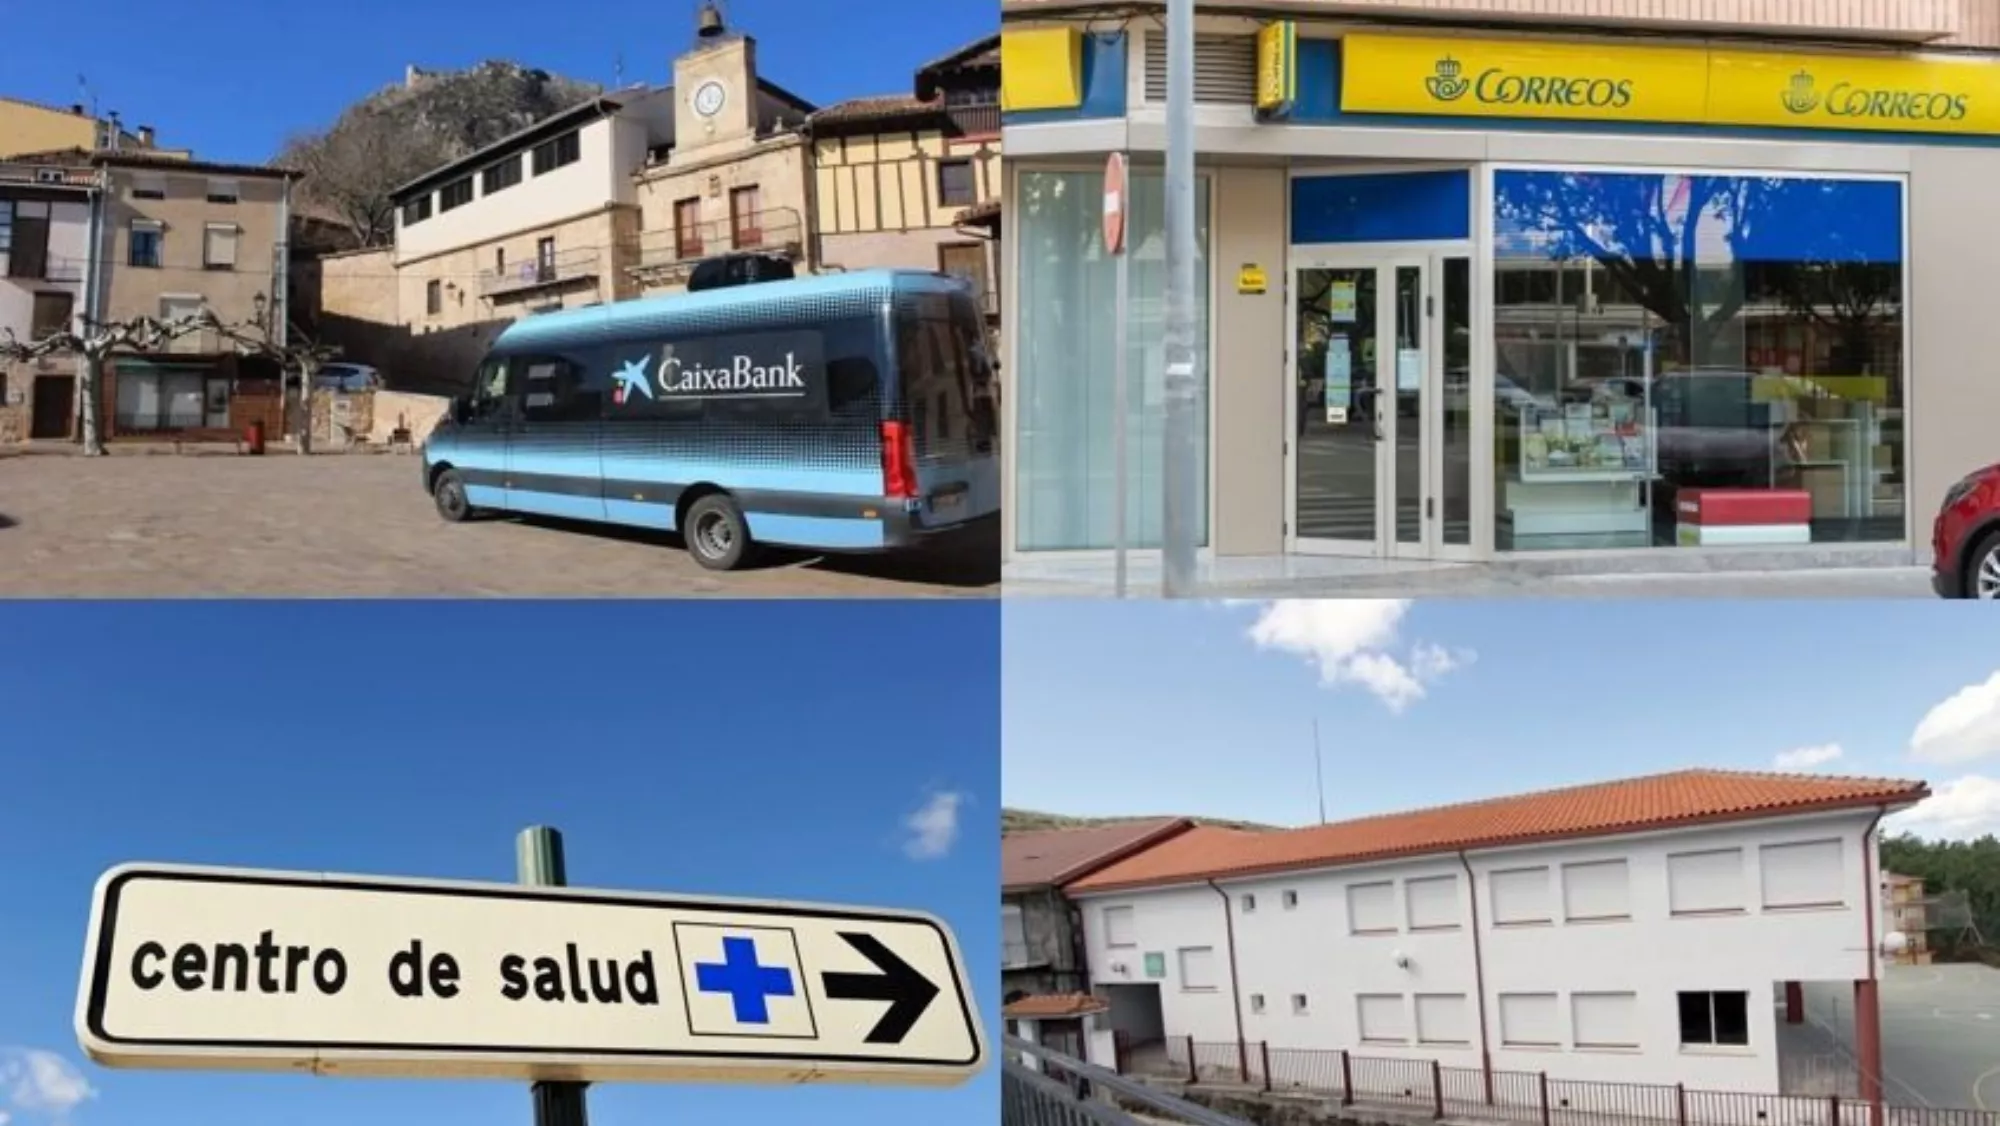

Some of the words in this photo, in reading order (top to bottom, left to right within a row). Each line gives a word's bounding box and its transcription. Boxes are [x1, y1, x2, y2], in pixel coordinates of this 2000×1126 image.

[1475, 67, 1634, 108] CORREOS
[1825, 82, 1968, 120] CORREOS
[658, 352, 805, 392] CaixaBank
[131, 929, 348, 994] centro
[388, 939, 461, 998] de
[500, 943, 660, 1005] salud
